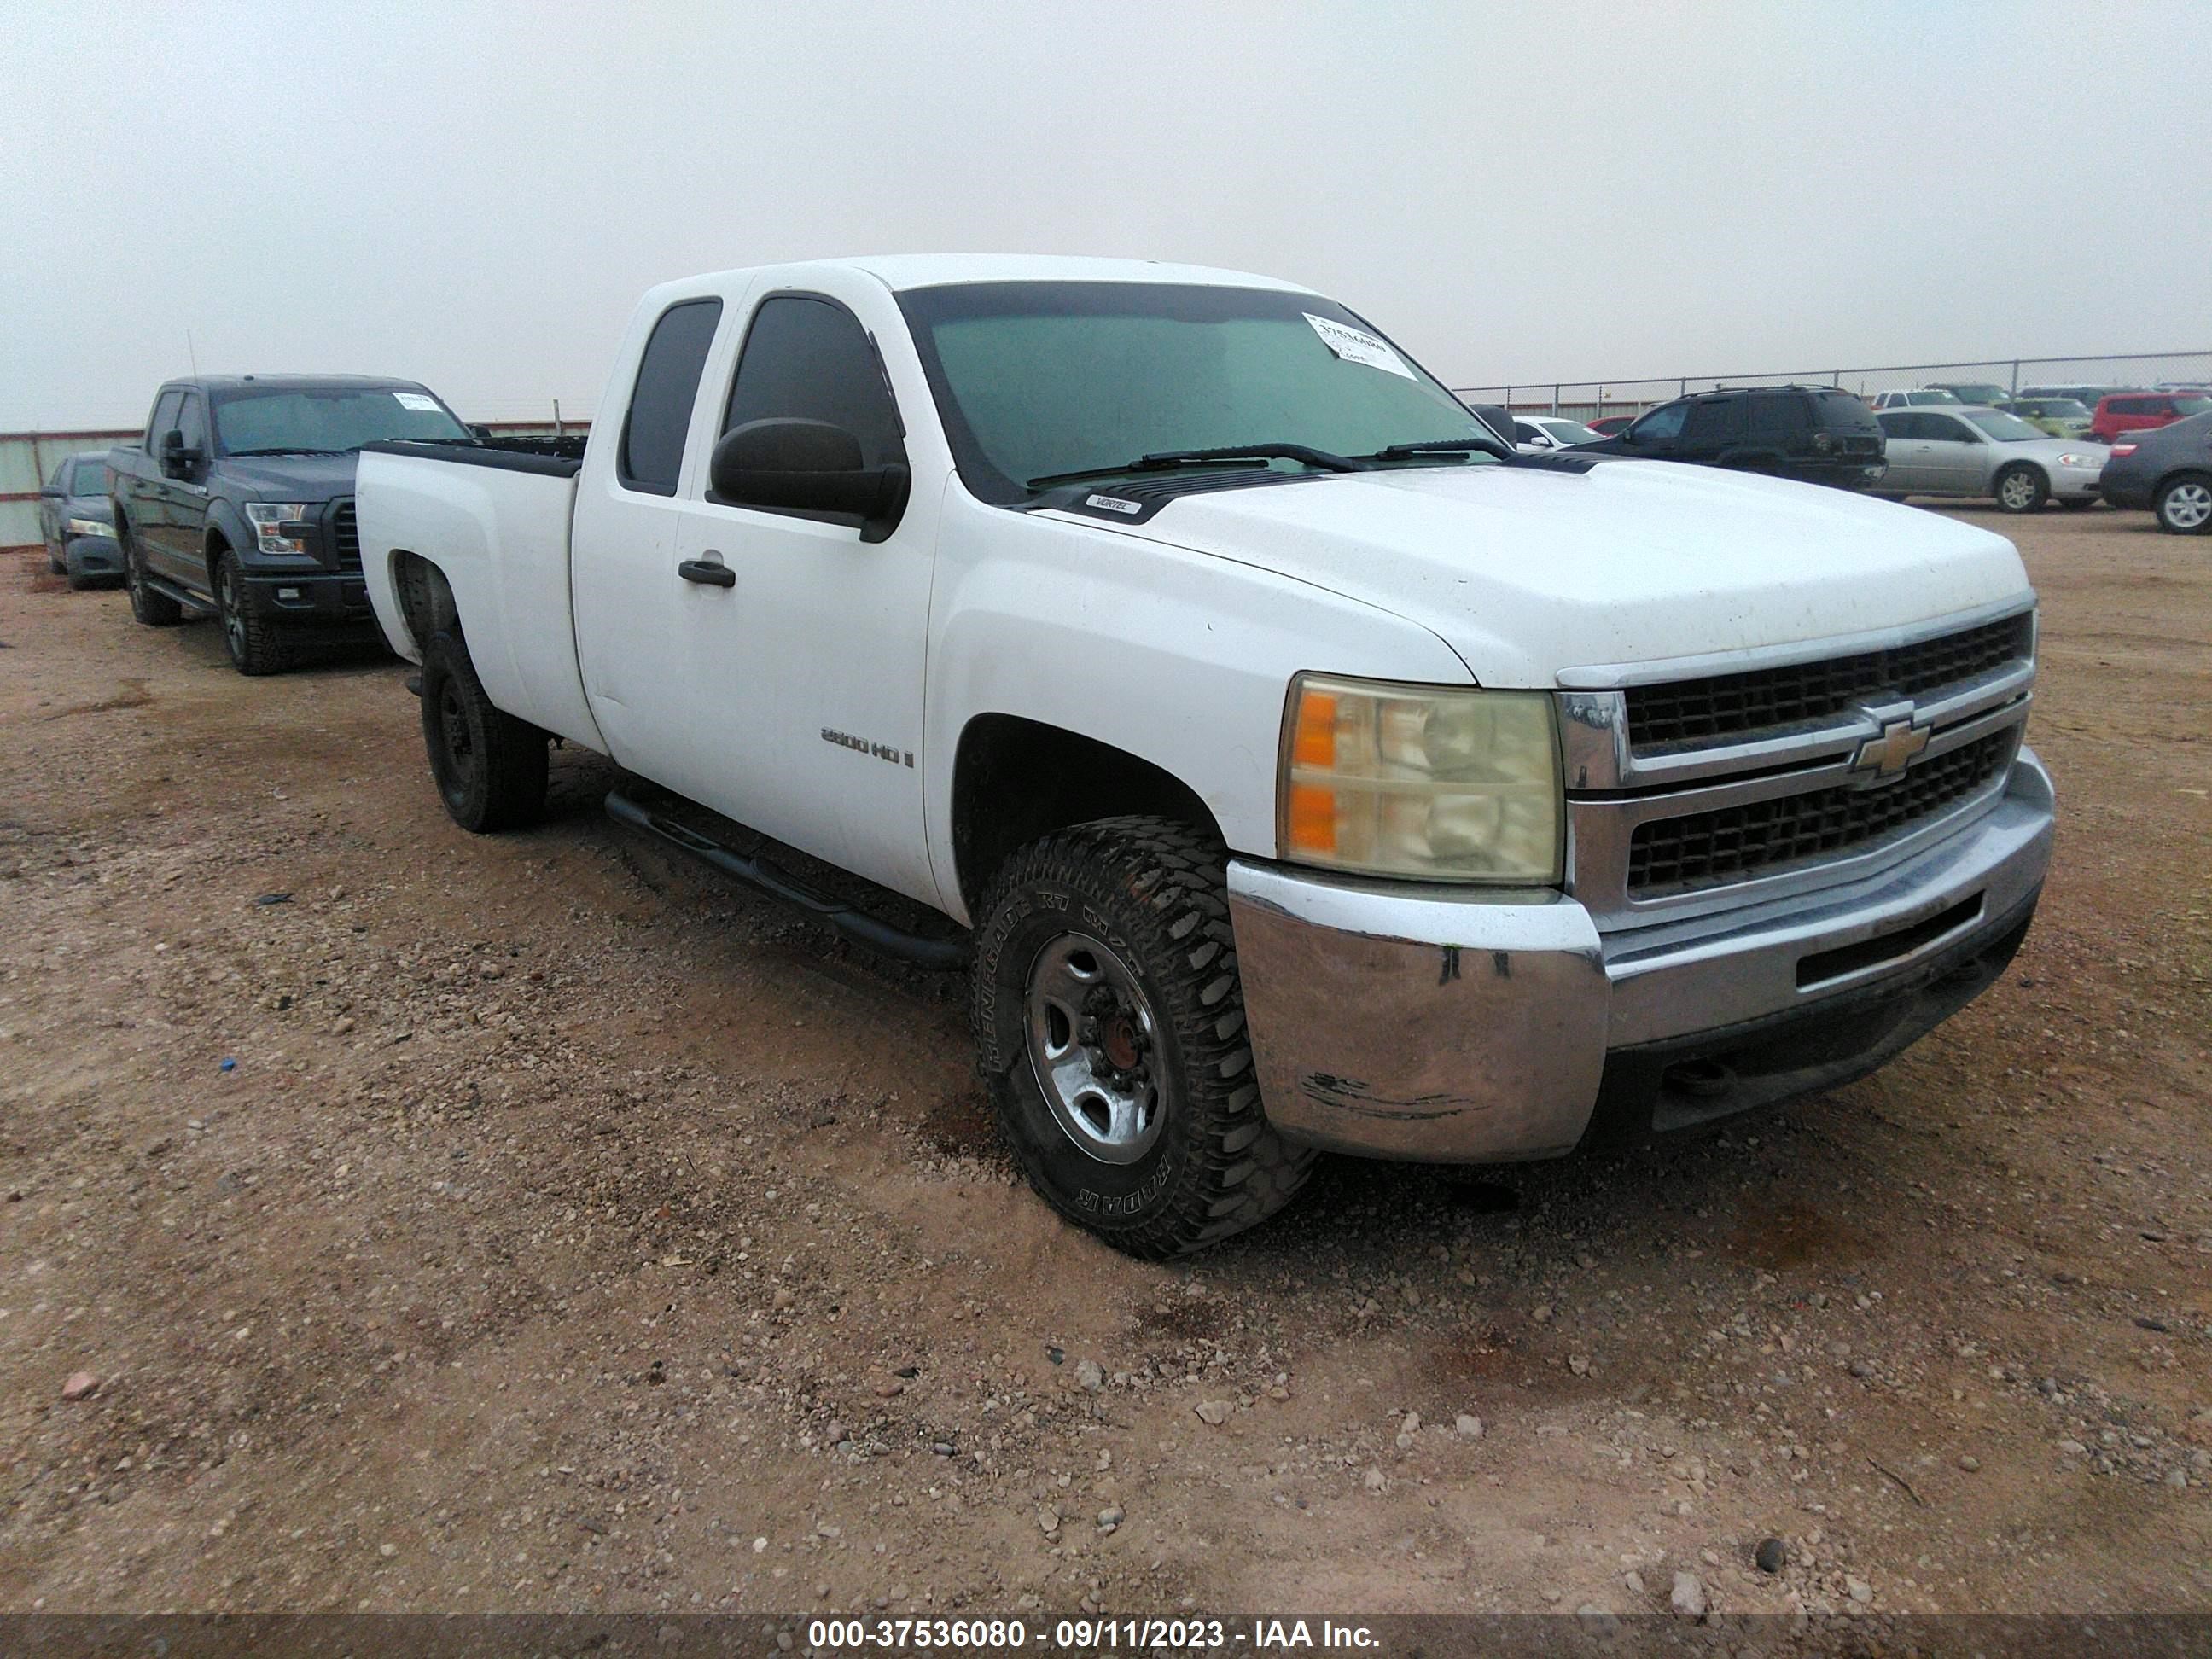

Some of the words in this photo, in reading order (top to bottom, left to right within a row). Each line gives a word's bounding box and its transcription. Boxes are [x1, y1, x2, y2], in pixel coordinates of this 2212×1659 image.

[1096, 497, 1132, 510] VORTEC
[820, 726, 869, 754] 2500
[871, 742, 899, 765] HD
